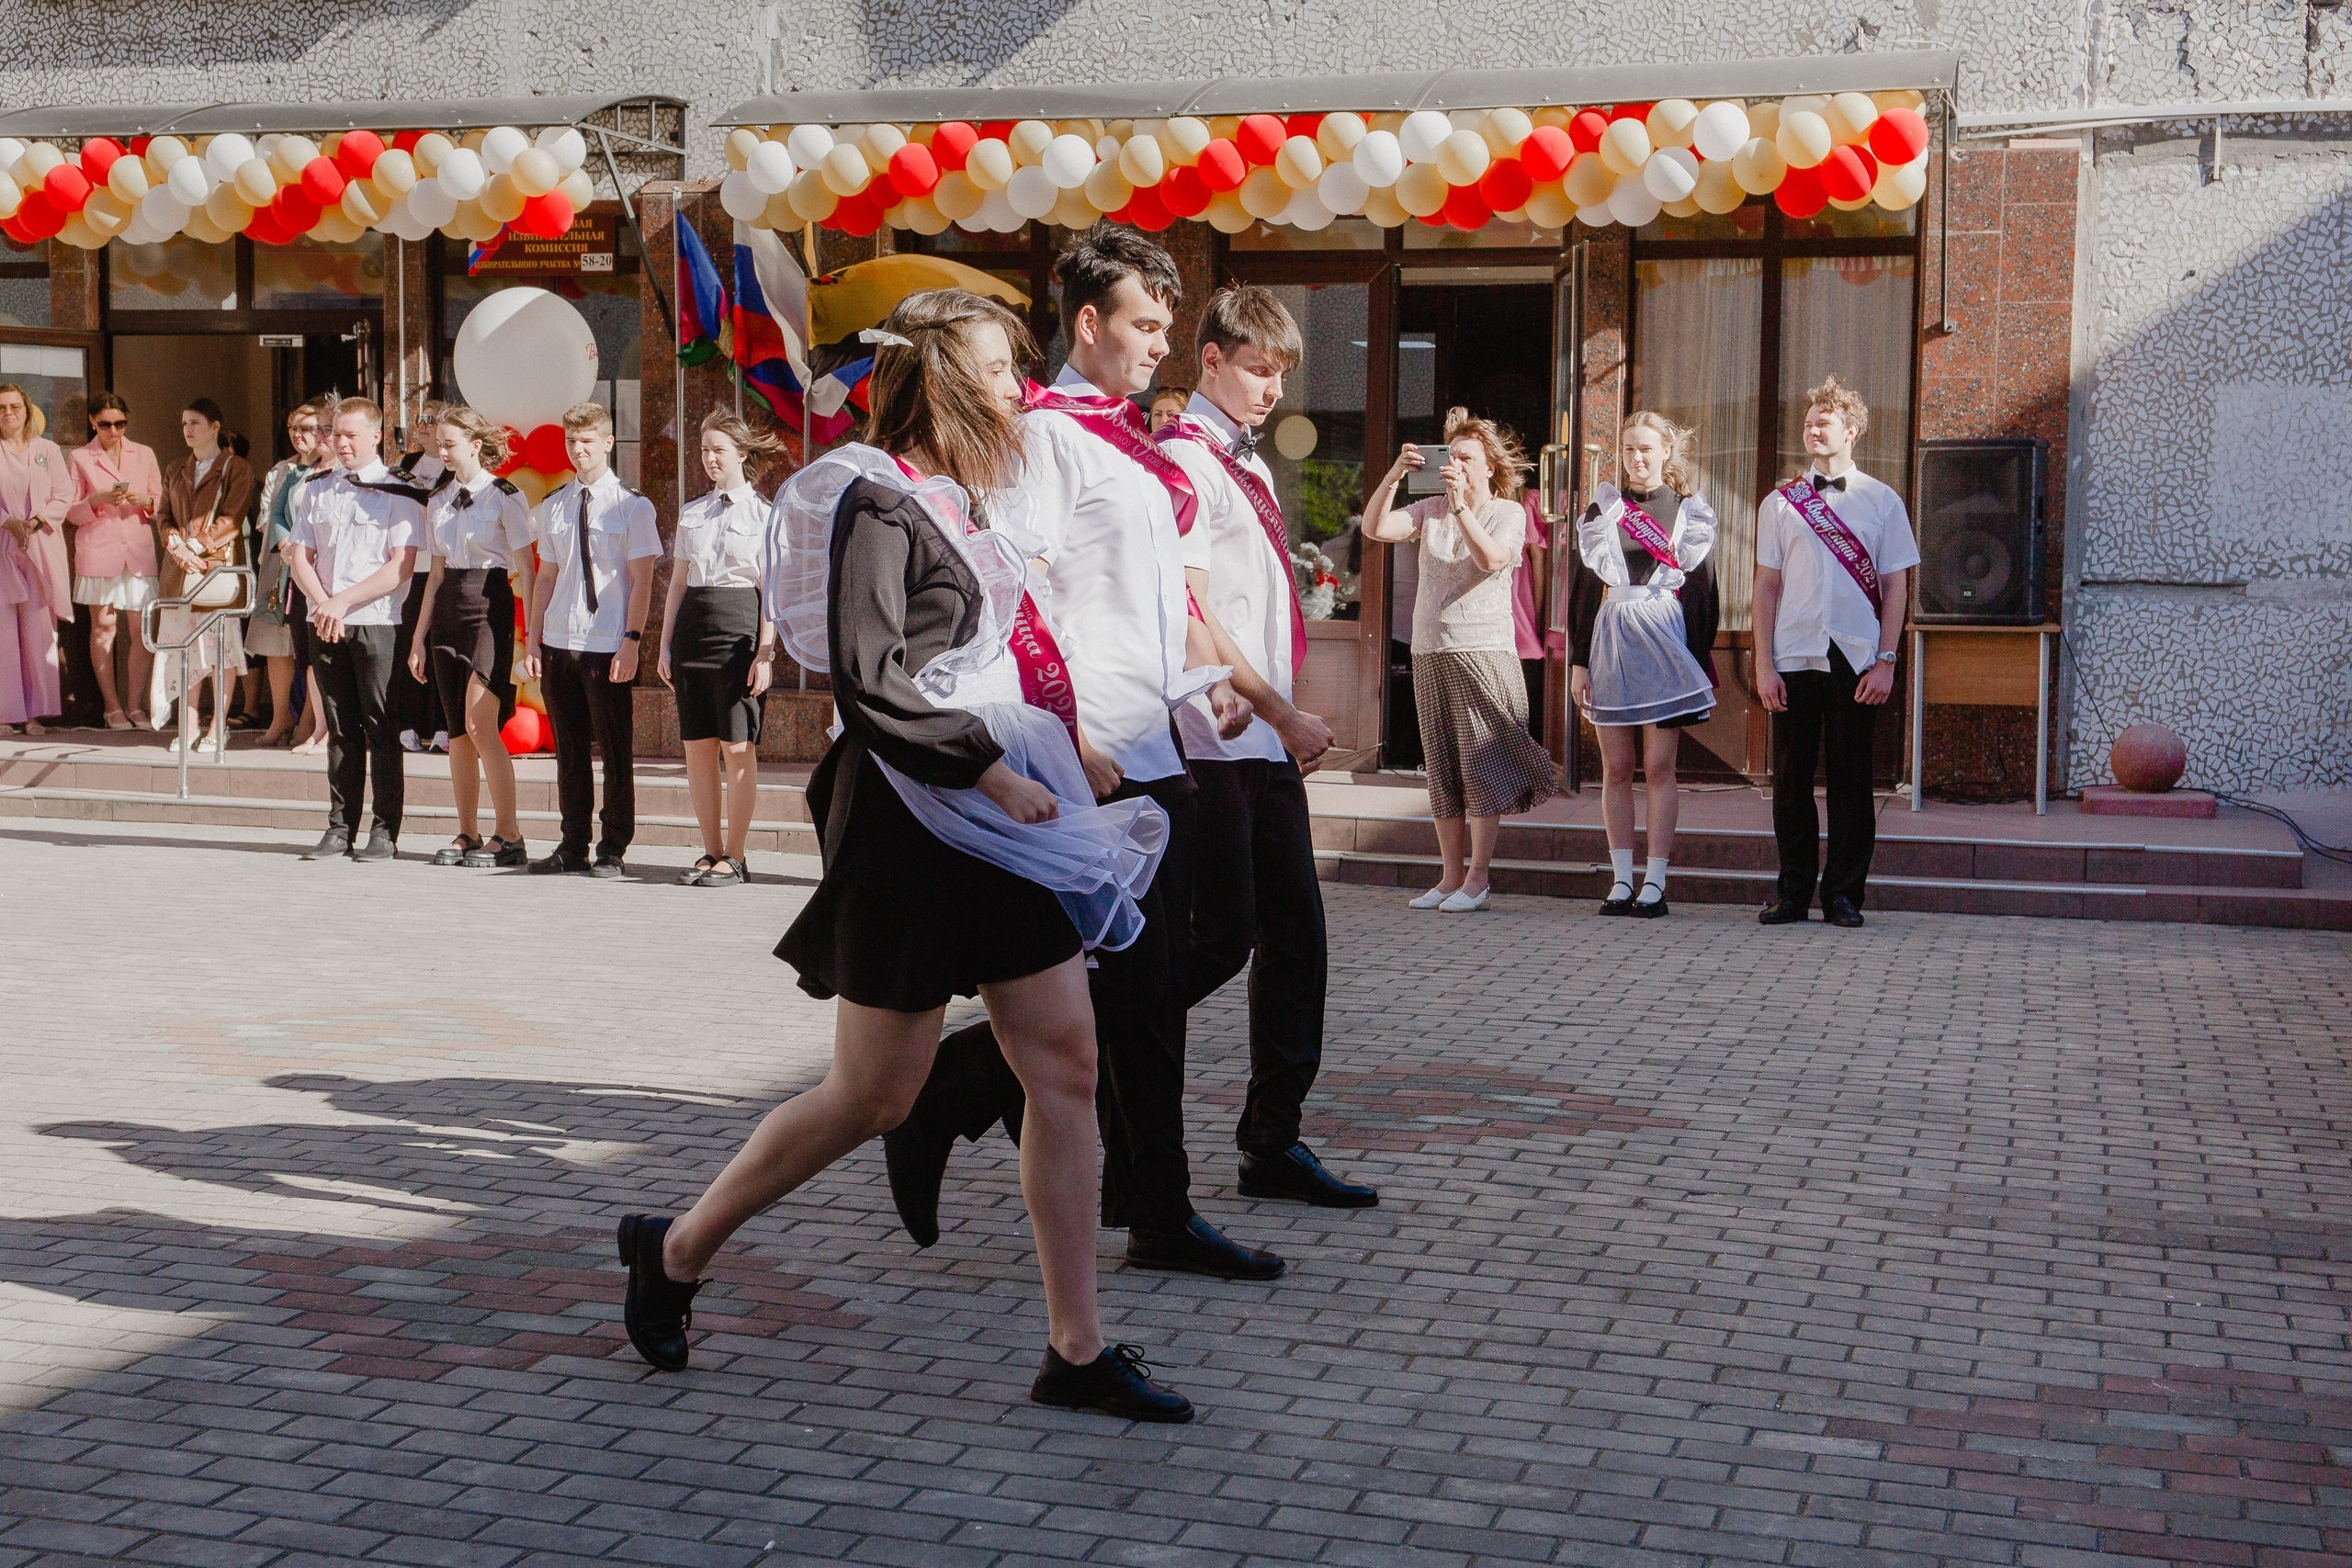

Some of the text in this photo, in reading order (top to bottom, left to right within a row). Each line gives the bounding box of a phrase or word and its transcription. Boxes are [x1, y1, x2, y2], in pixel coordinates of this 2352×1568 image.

[525, 243, 588, 253] КОМИССИЯ
[475, 260, 537, 268] ИЗБИРАТЕЛЬНОГО
[1110, 430, 1133, 447] МАОУ
[1146, 454, 1163, 469] СОШ
[1804, 499, 1858, 561] Выпускник
